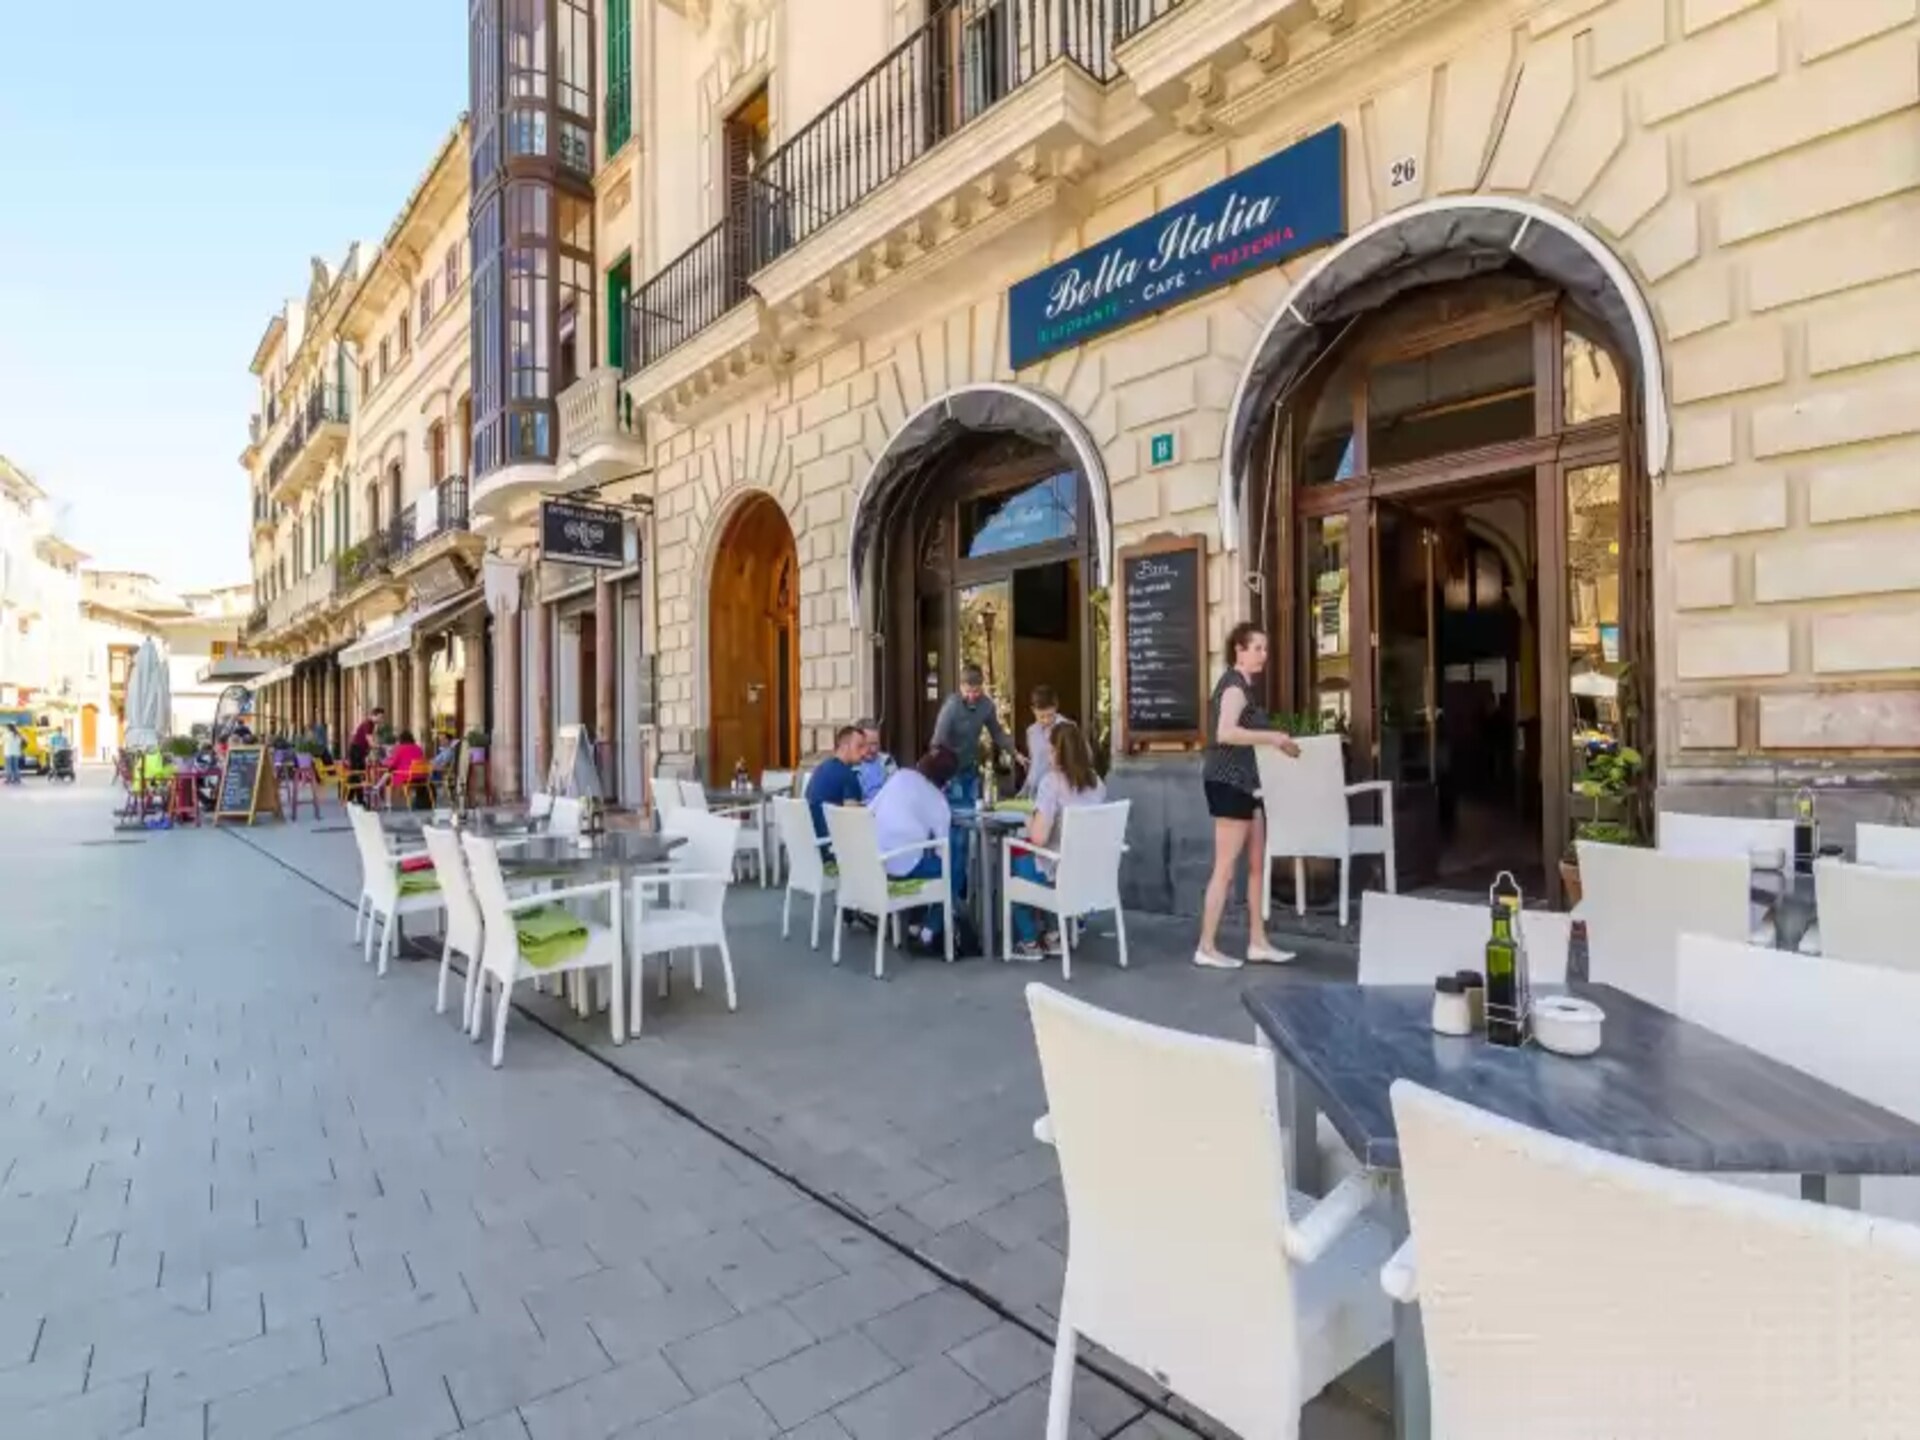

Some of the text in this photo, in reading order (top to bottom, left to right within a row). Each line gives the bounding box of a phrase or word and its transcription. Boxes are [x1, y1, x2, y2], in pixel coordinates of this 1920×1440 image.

[1391, 157, 1416, 187] 26
[1046, 193, 1280, 318] Bella Italia
